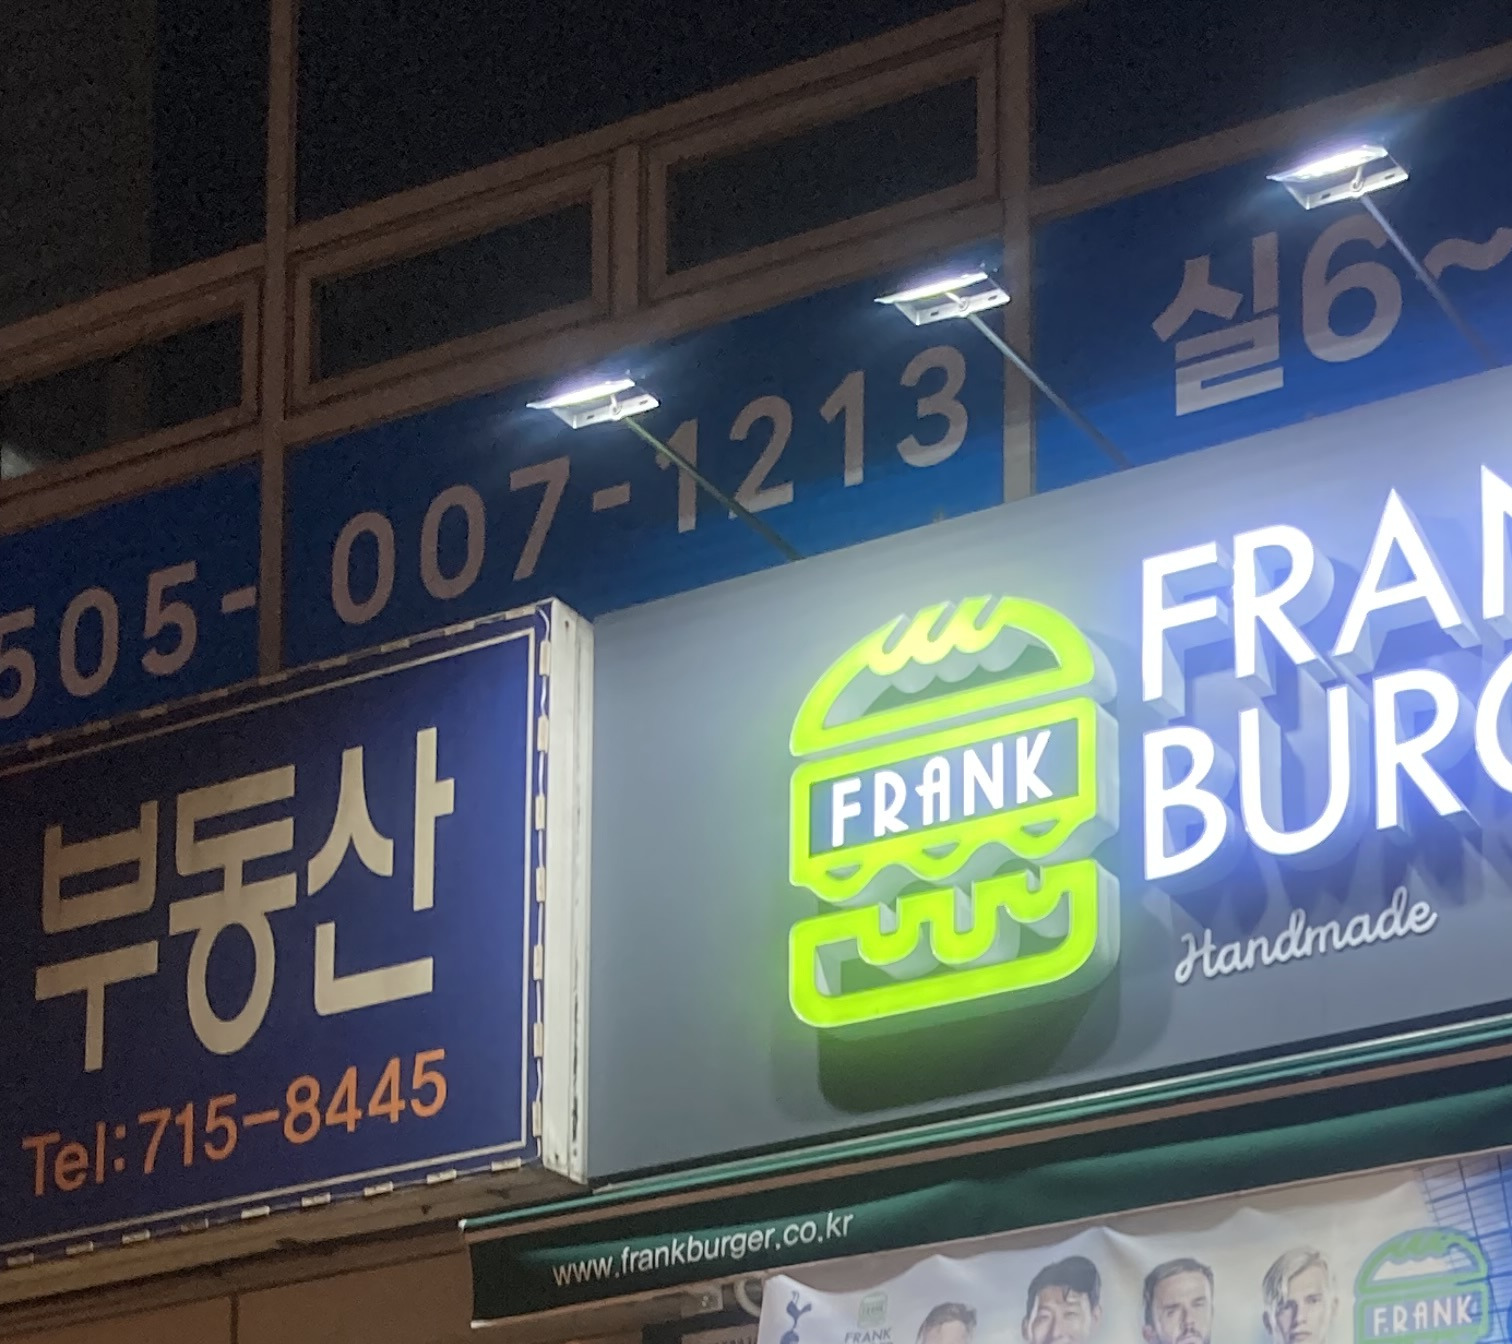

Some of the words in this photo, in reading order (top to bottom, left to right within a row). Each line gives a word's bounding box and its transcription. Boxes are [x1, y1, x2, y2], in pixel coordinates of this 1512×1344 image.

[830, 728, 1055, 848] FRANK
[36, 726, 455, 1073] 부동산
[1173, 892, 1437, 983] Handmade
[552, 1211, 854, 1288] www.frankburger.co.kr
[844, 1327, 894, 1344] FRANK
[1371, 1293, 1473, 1337] FRANK
